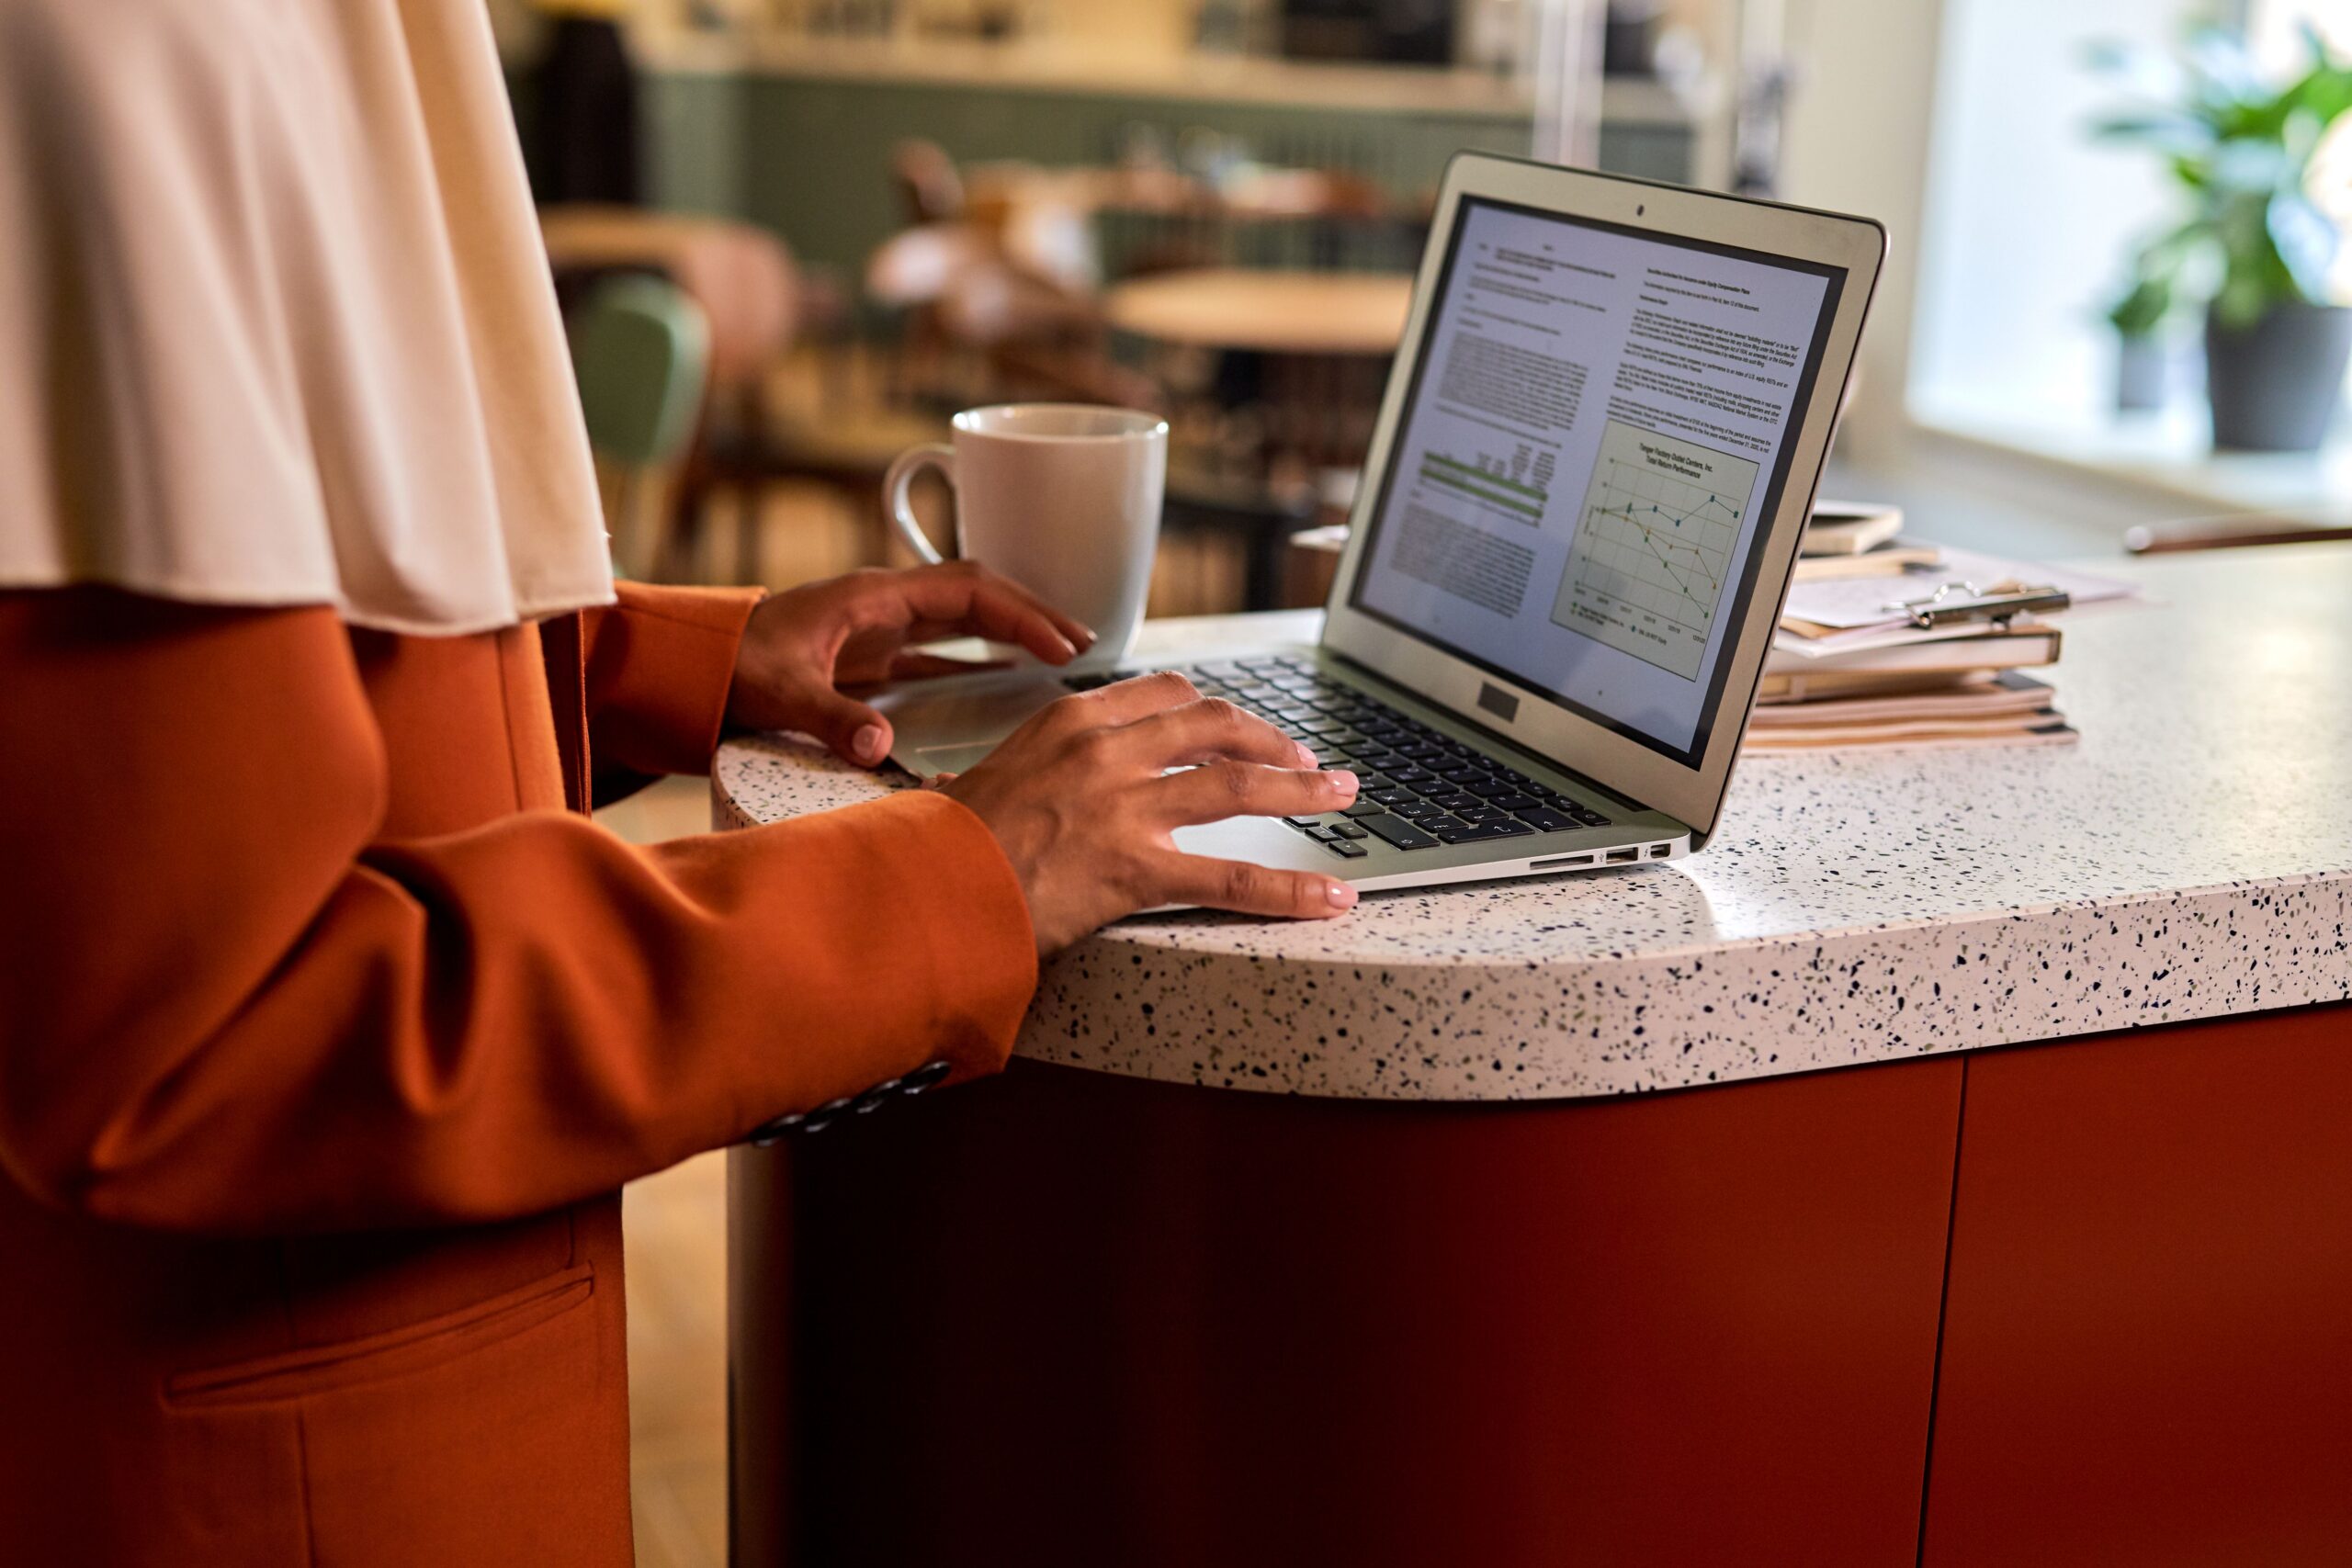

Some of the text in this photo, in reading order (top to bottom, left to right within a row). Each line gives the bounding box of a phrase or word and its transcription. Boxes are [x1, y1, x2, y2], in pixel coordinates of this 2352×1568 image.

[1717, 284, 1741, 293] Compensation
[1775, 350, 1791, 358] Securities
[1778, 359, 1794, 367] Exchange
[1742, 396, 1761, 405] investments
[1737, 402, 1752, 411] shopping
[1709, 424, 1724, 433] beginning
[1751, 436, 1766, 445] assumes
[1728, 438, 1745, 446] December
[1654, 448, 1671, 460] Factory
[1671, 453, 1686, 464] Outlet
[1685, 457, 1705, 470] Centers,
[1704, 463, 1714, 472] Inc.
[1646, 456, 1702, 479] Total Return Performance
